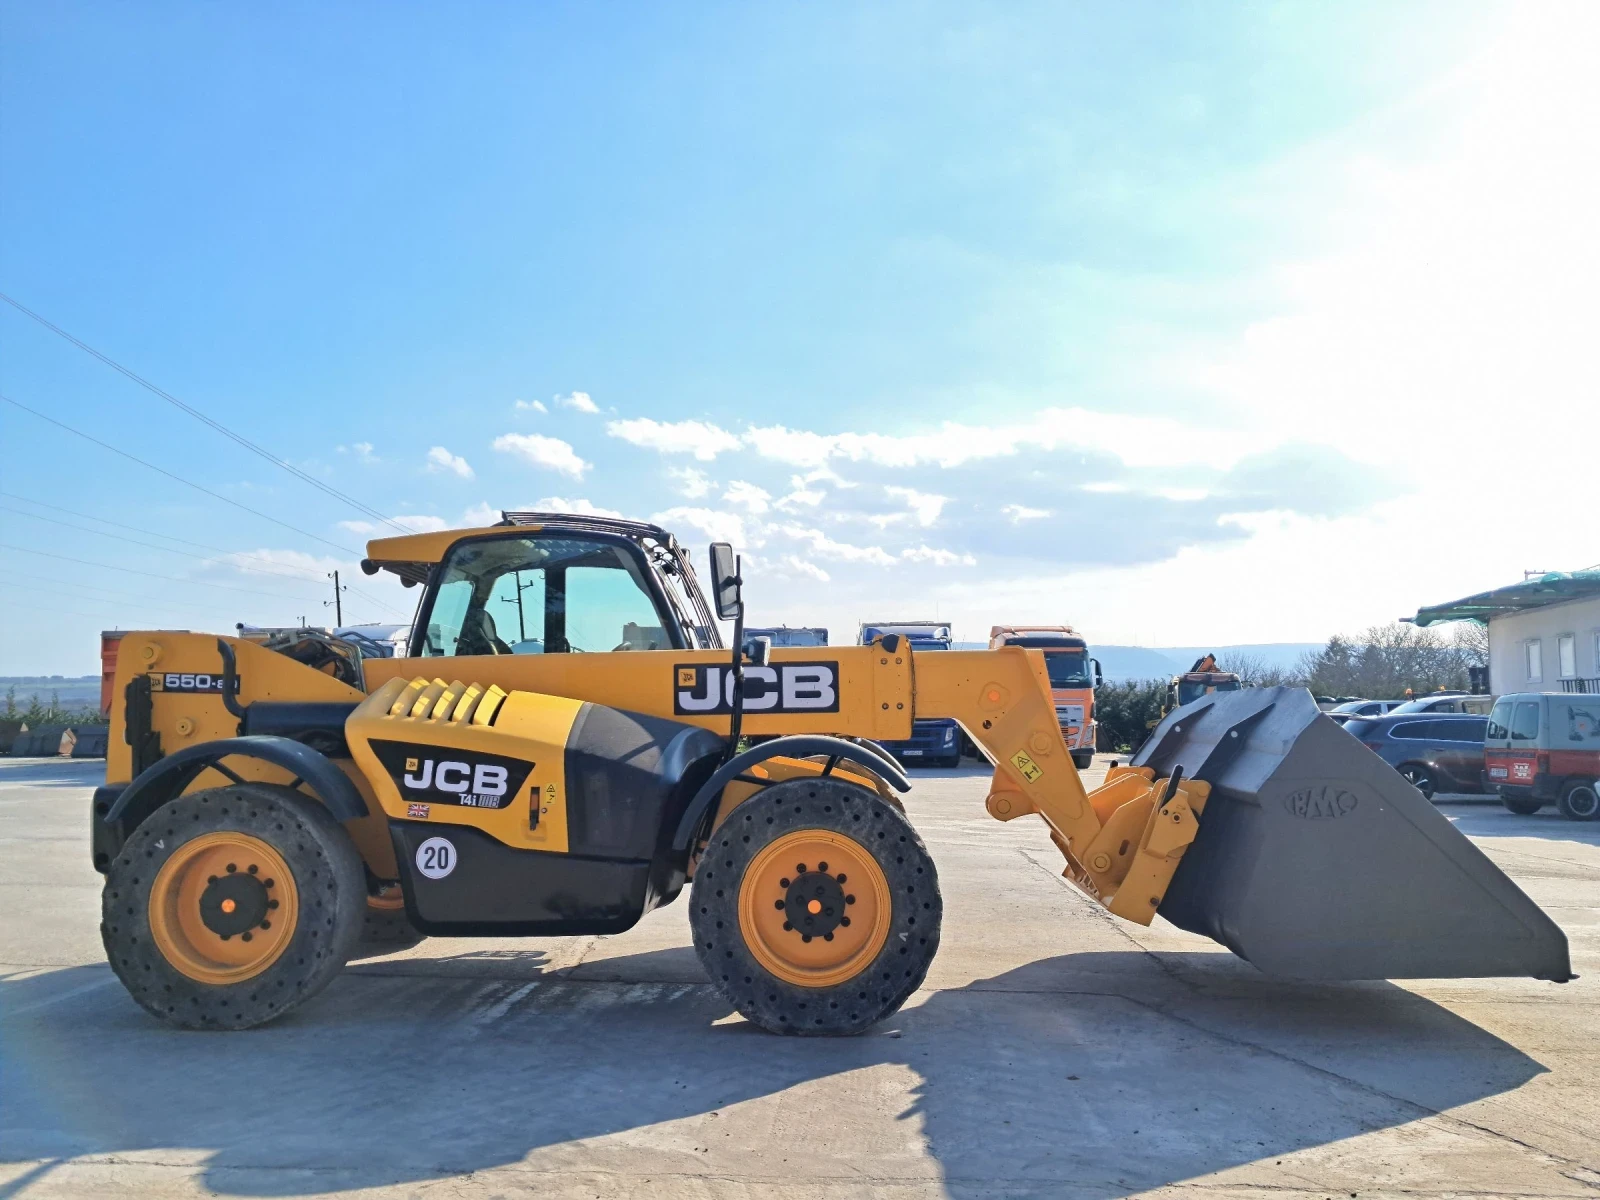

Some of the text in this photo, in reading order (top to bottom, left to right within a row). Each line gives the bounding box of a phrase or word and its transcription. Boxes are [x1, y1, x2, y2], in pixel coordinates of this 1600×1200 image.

[165, 673, 238, 689] 550-8
[678, 666, 835, 711] JCB
[404, 759, 508, 796] JCB
[424, 846, 449, 870] 20
